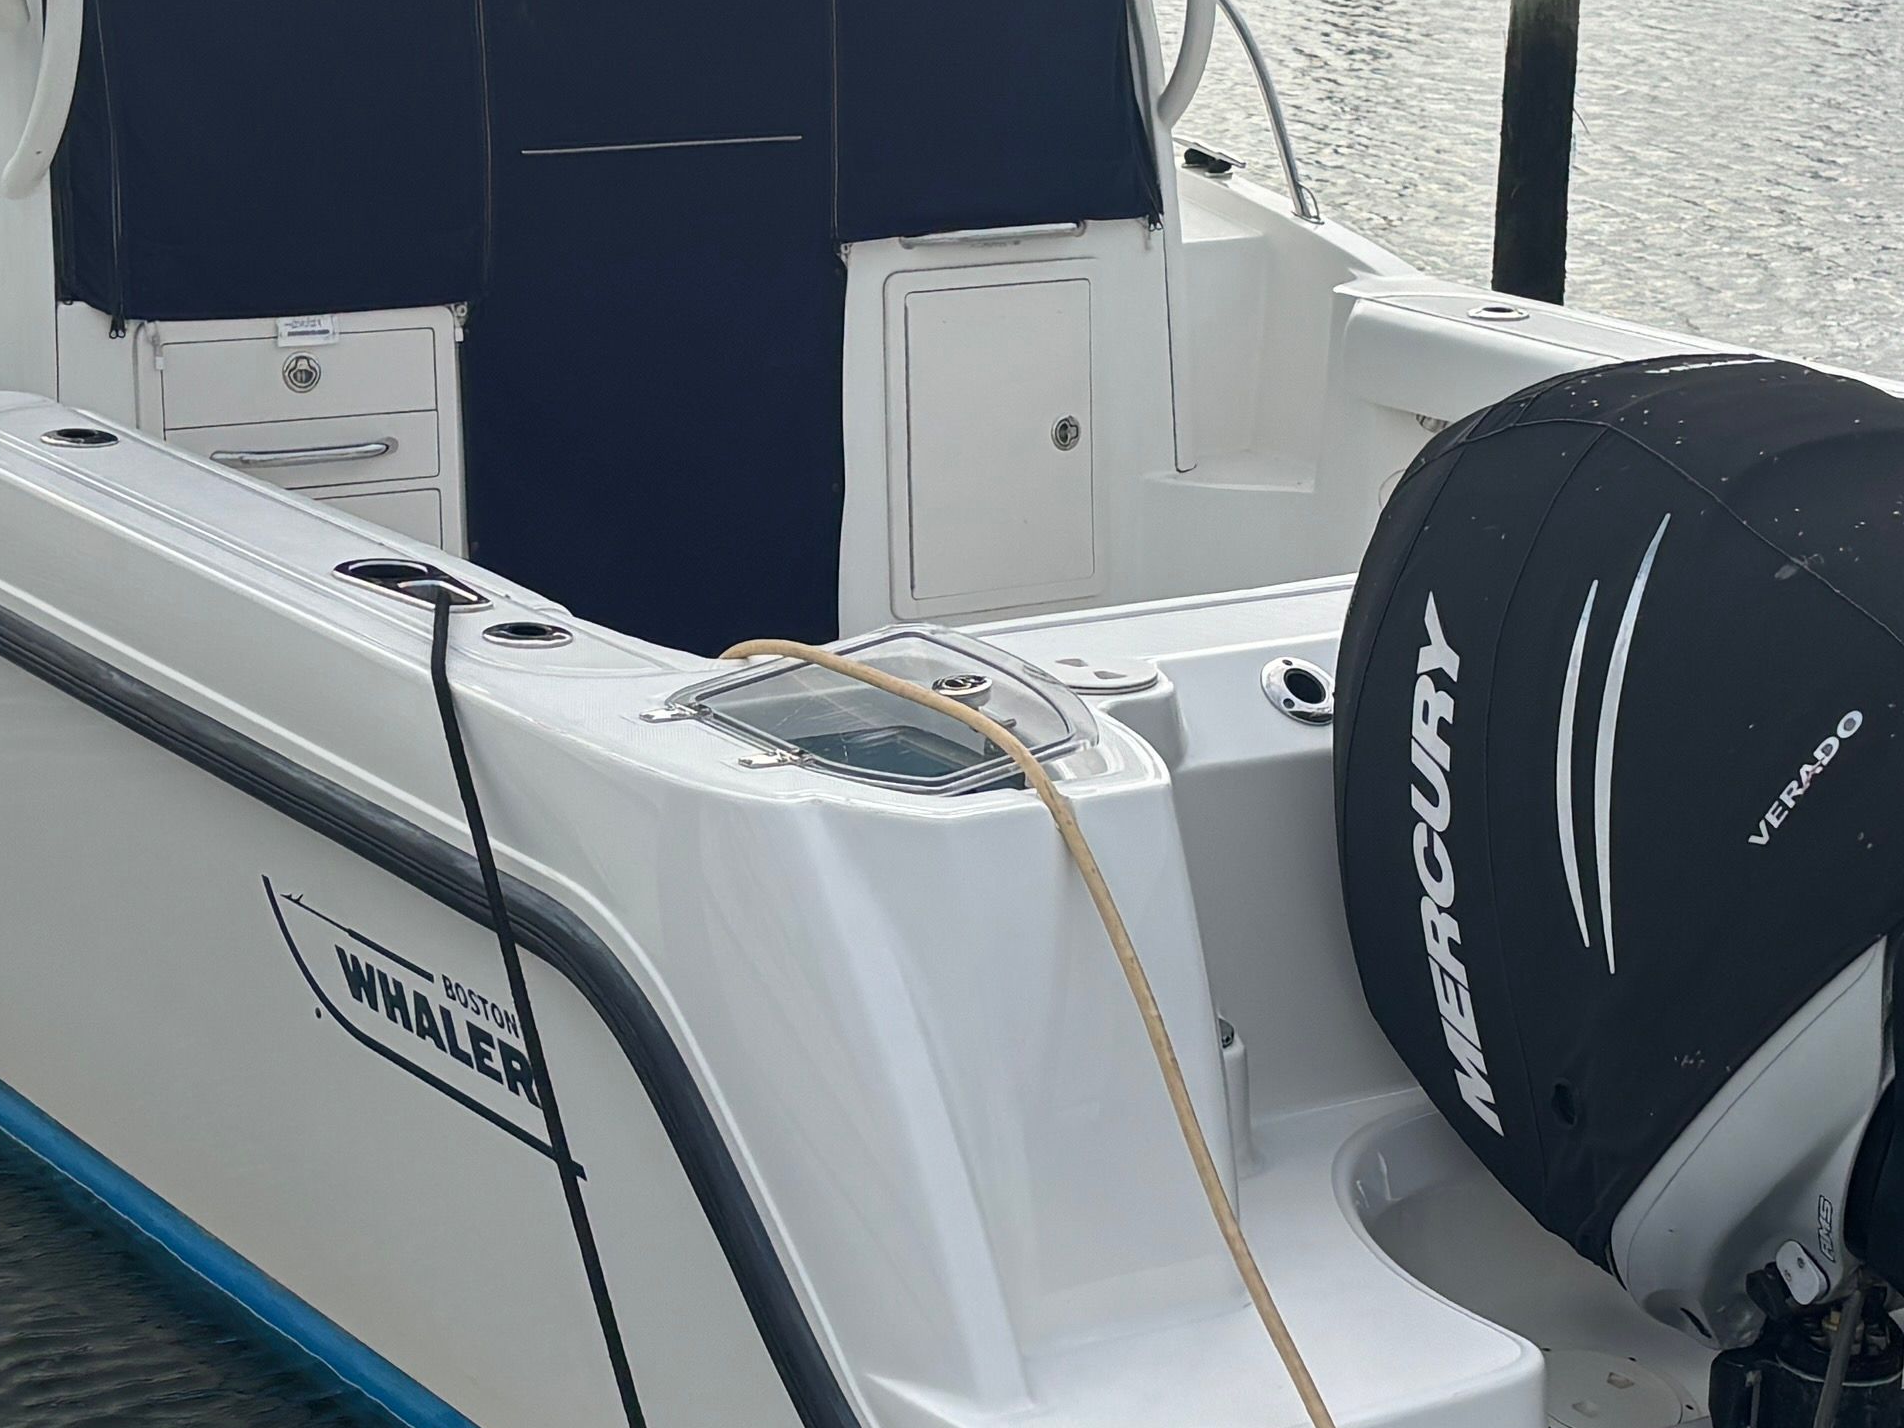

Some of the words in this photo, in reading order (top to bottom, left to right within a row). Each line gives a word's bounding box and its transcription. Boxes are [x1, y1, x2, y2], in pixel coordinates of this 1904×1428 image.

[1747, 709, 1864, 846] VERADO
[1410, 590, 1505, 1138] MERCURY
[334, 943, 545, 1111] WHALER
[441, 973, 520, 1040] BOSTON
